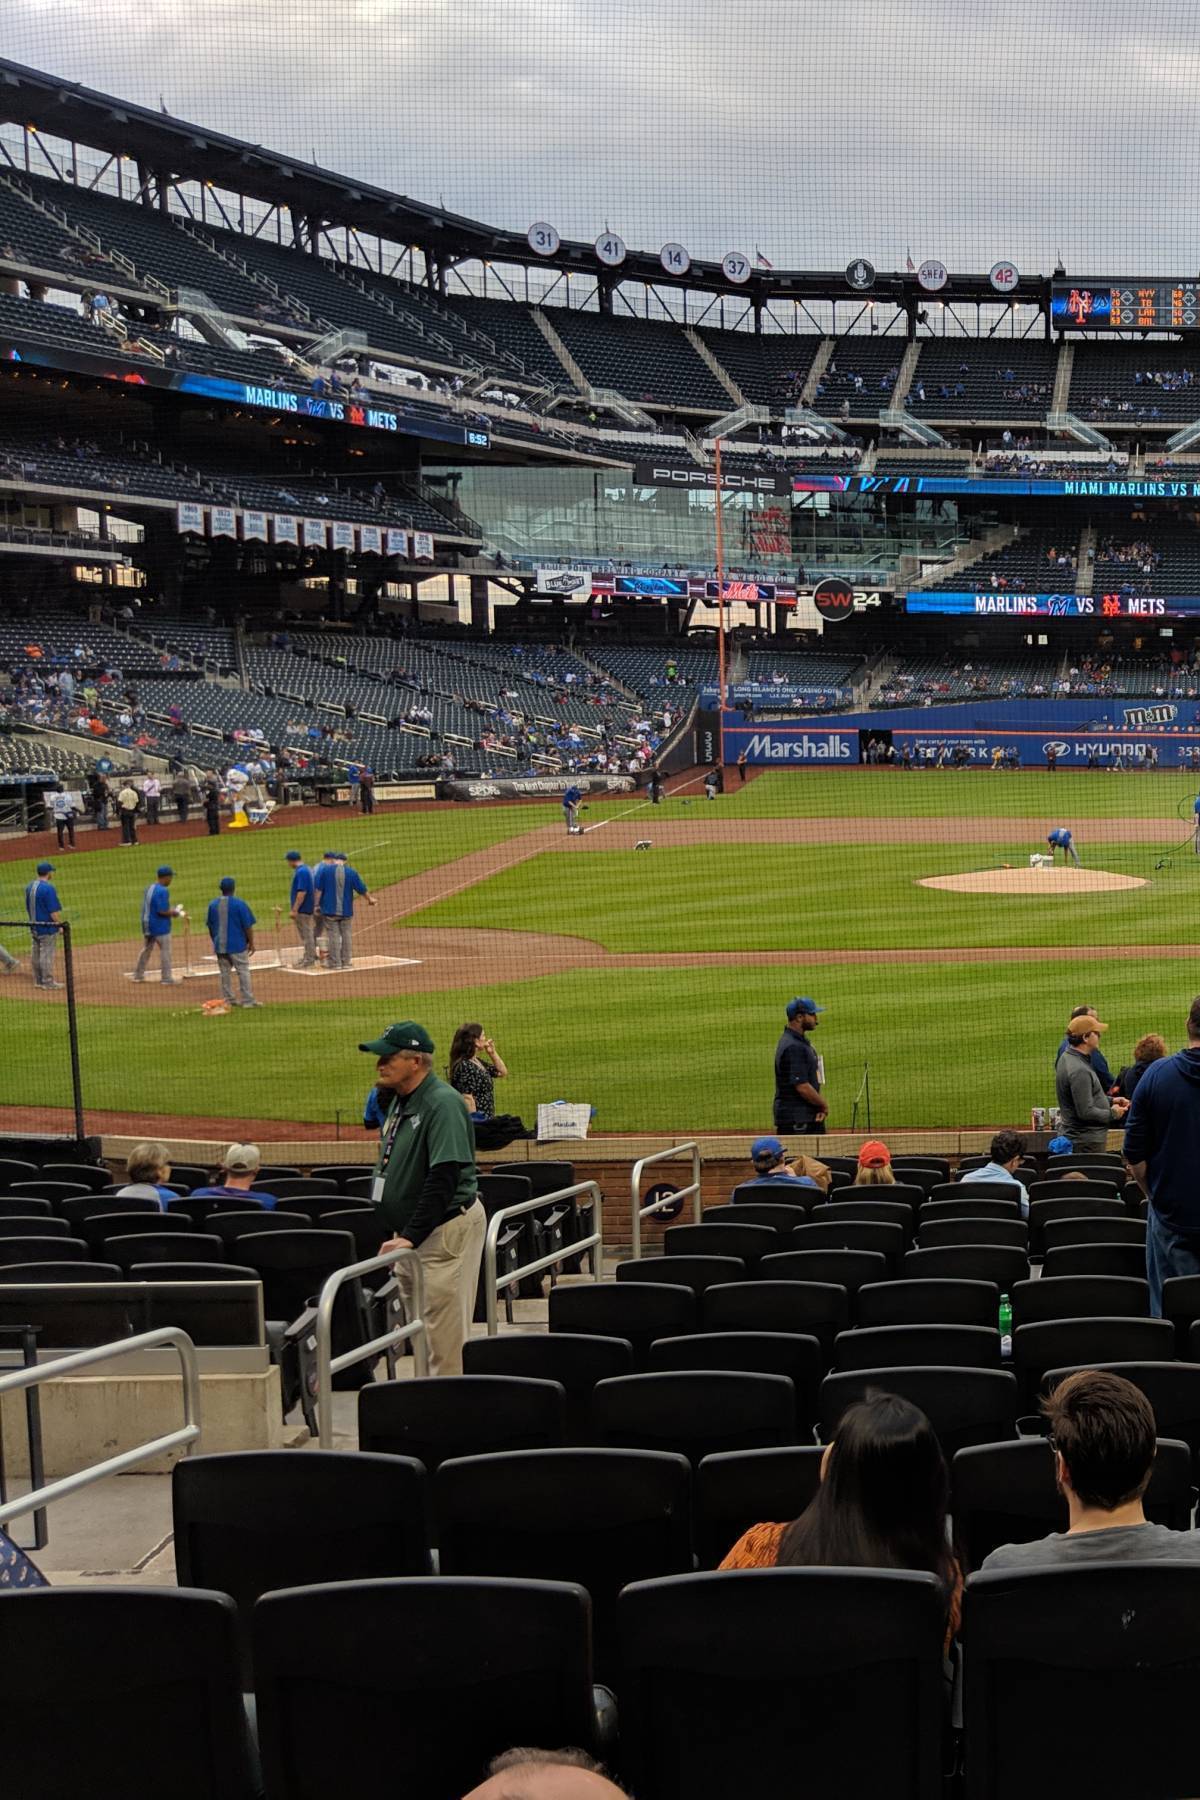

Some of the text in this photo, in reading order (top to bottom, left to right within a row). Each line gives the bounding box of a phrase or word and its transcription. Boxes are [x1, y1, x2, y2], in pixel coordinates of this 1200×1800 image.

[536, 230, 552, 246] 31
[603, 241, 618, 257] 41
[668, 250, 682, 266] 14
[728, 260, 744, 275] 37
[921, 270, 943, 280] SHEA
[995, 269, 1013, 283] 42
[246, 385, 398, 431] MARLINS VS METS
[469, 432, 488, 446] 6:52
[653, 469, 775, 489] PORSCHE
[1065, 481, 1103, 495] MIAMI
[1109, 482, 1165, 496] MARLINS
[1171, 482, 1187, 496] VS
[722, 581, 759, 600] Mets
[816, 592, 881, 608] SW 24
[975, 596, 1165, 614] MARLINS VS METS
[705, 731, 713, 762] 335
[744, 734, 850, 758] Marshalls
[654, 1191, 675, 1212] 12
